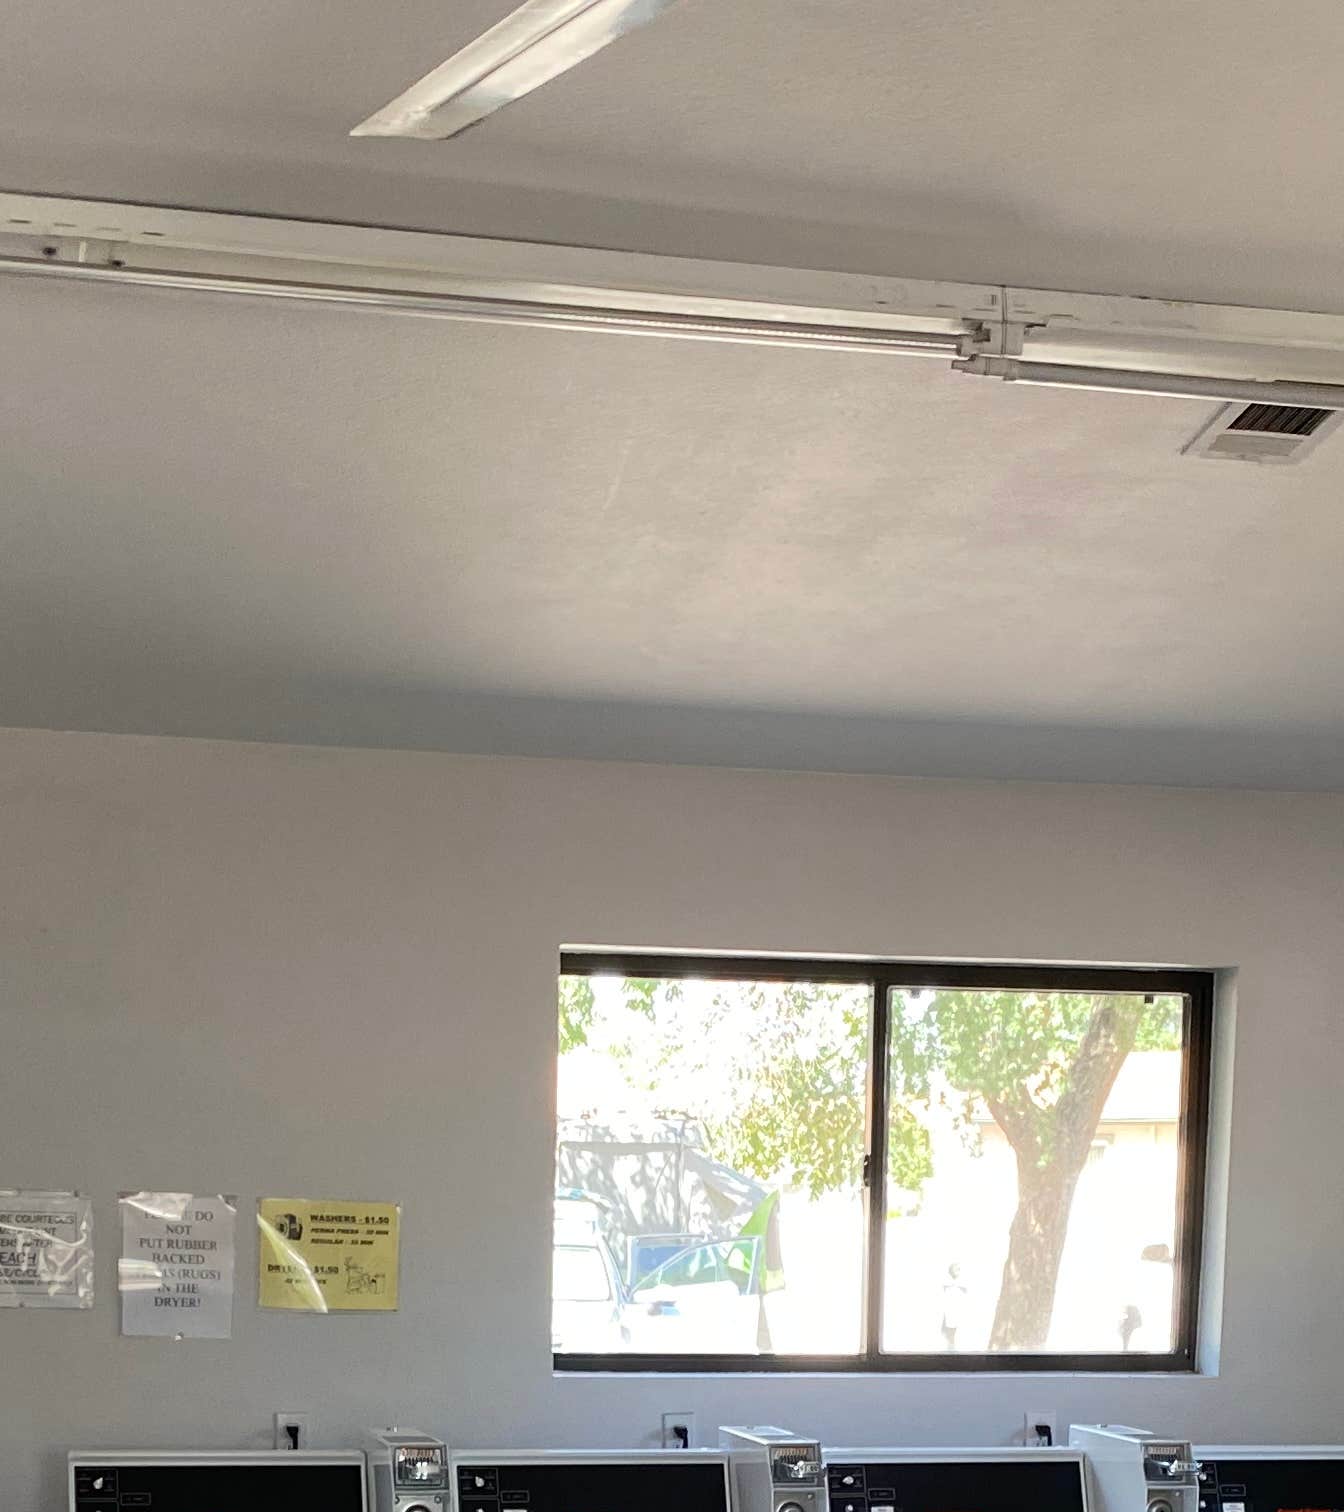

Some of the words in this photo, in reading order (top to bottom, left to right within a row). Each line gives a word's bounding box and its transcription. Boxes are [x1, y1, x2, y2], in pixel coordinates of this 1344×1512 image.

[0, 1214, 11, 1223] BE
[195, 1210, 214, 1222] DO
[310, 1214, 356, 1224] WASHERS
[365, 1216, 390, 1225] $1.50
[166, 1224, 193, 1236] NOT
[138, 1237, 165, 1249] PUT
[167, 1239, 217, 1251] RUBBER
[0, 1252, 37, 1263] EACH
[152, 1252, 206, 1265] BACKED
[178, 1268, 221, 1281] (RUGS)
[175, 1283, 199, 1294] THE
[154, 1297, 201, 1308] DRYER!
